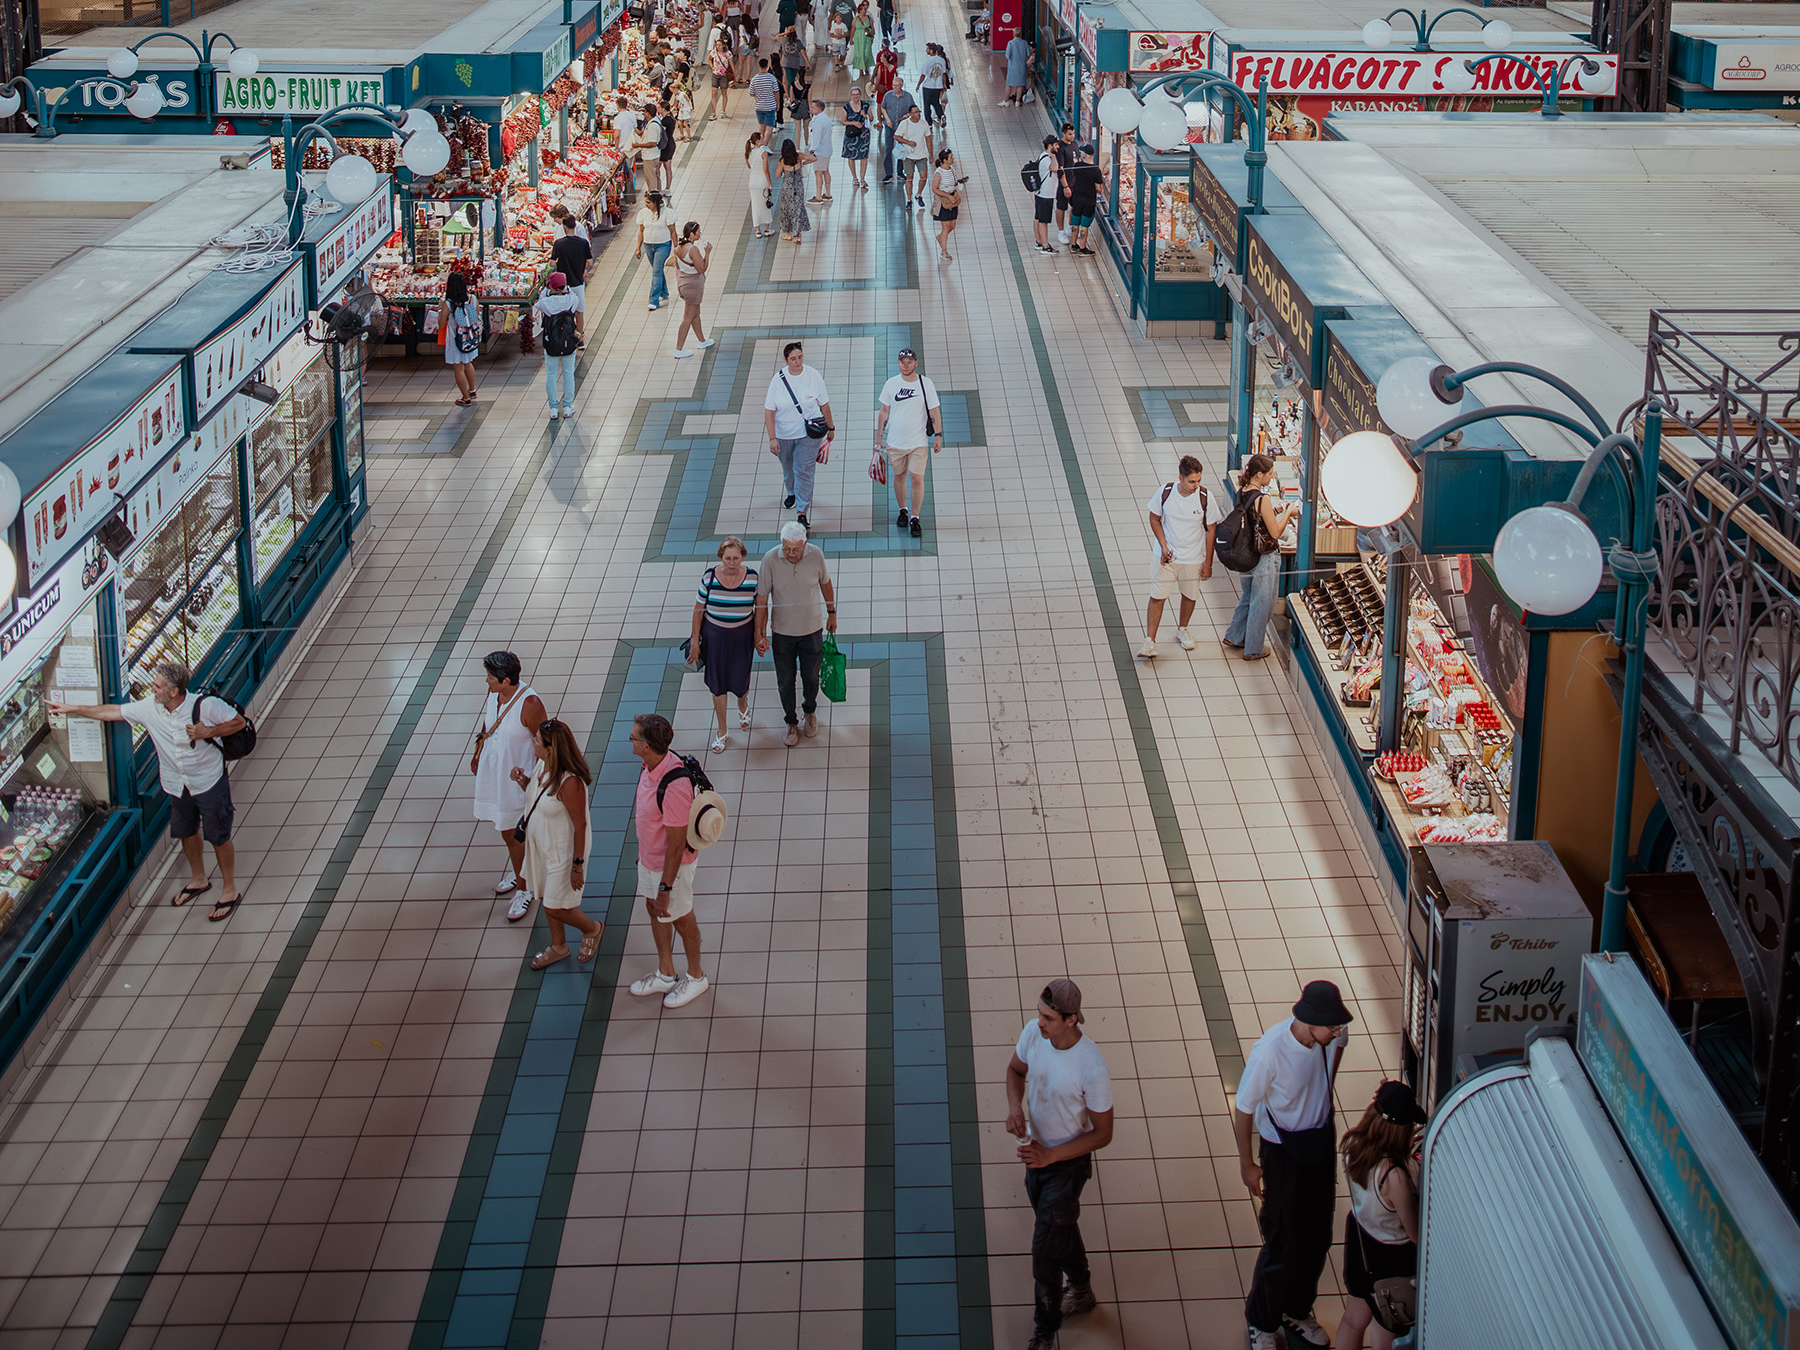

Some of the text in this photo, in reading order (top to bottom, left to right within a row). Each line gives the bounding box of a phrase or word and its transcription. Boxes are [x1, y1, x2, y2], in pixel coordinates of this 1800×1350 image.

[1235, 53, 1421, 90] FELVÁGOTT
[1727, 70, 1761, 78] AGROCORP
[223, 77, 341, 111] AGRO-FRUIT
[1331, 100, 1419, 112] KABANOS
[1782, 95, 1800, 106] K
[899, 387, 915, 397] NIKE
[1327, 355, 1371, 431] Chocolate
[12, 584, 60, 642] UNICUM
[1509, 938, 1560, 950] Tchibo
[1477, 966, 1567, 1006] Simply
[1475, 1003, 1567, 1023] ENJOY
[1584, 971, 1784, 1349] Tourist information
[1630, 1124, 1689, 1238] panaszok
